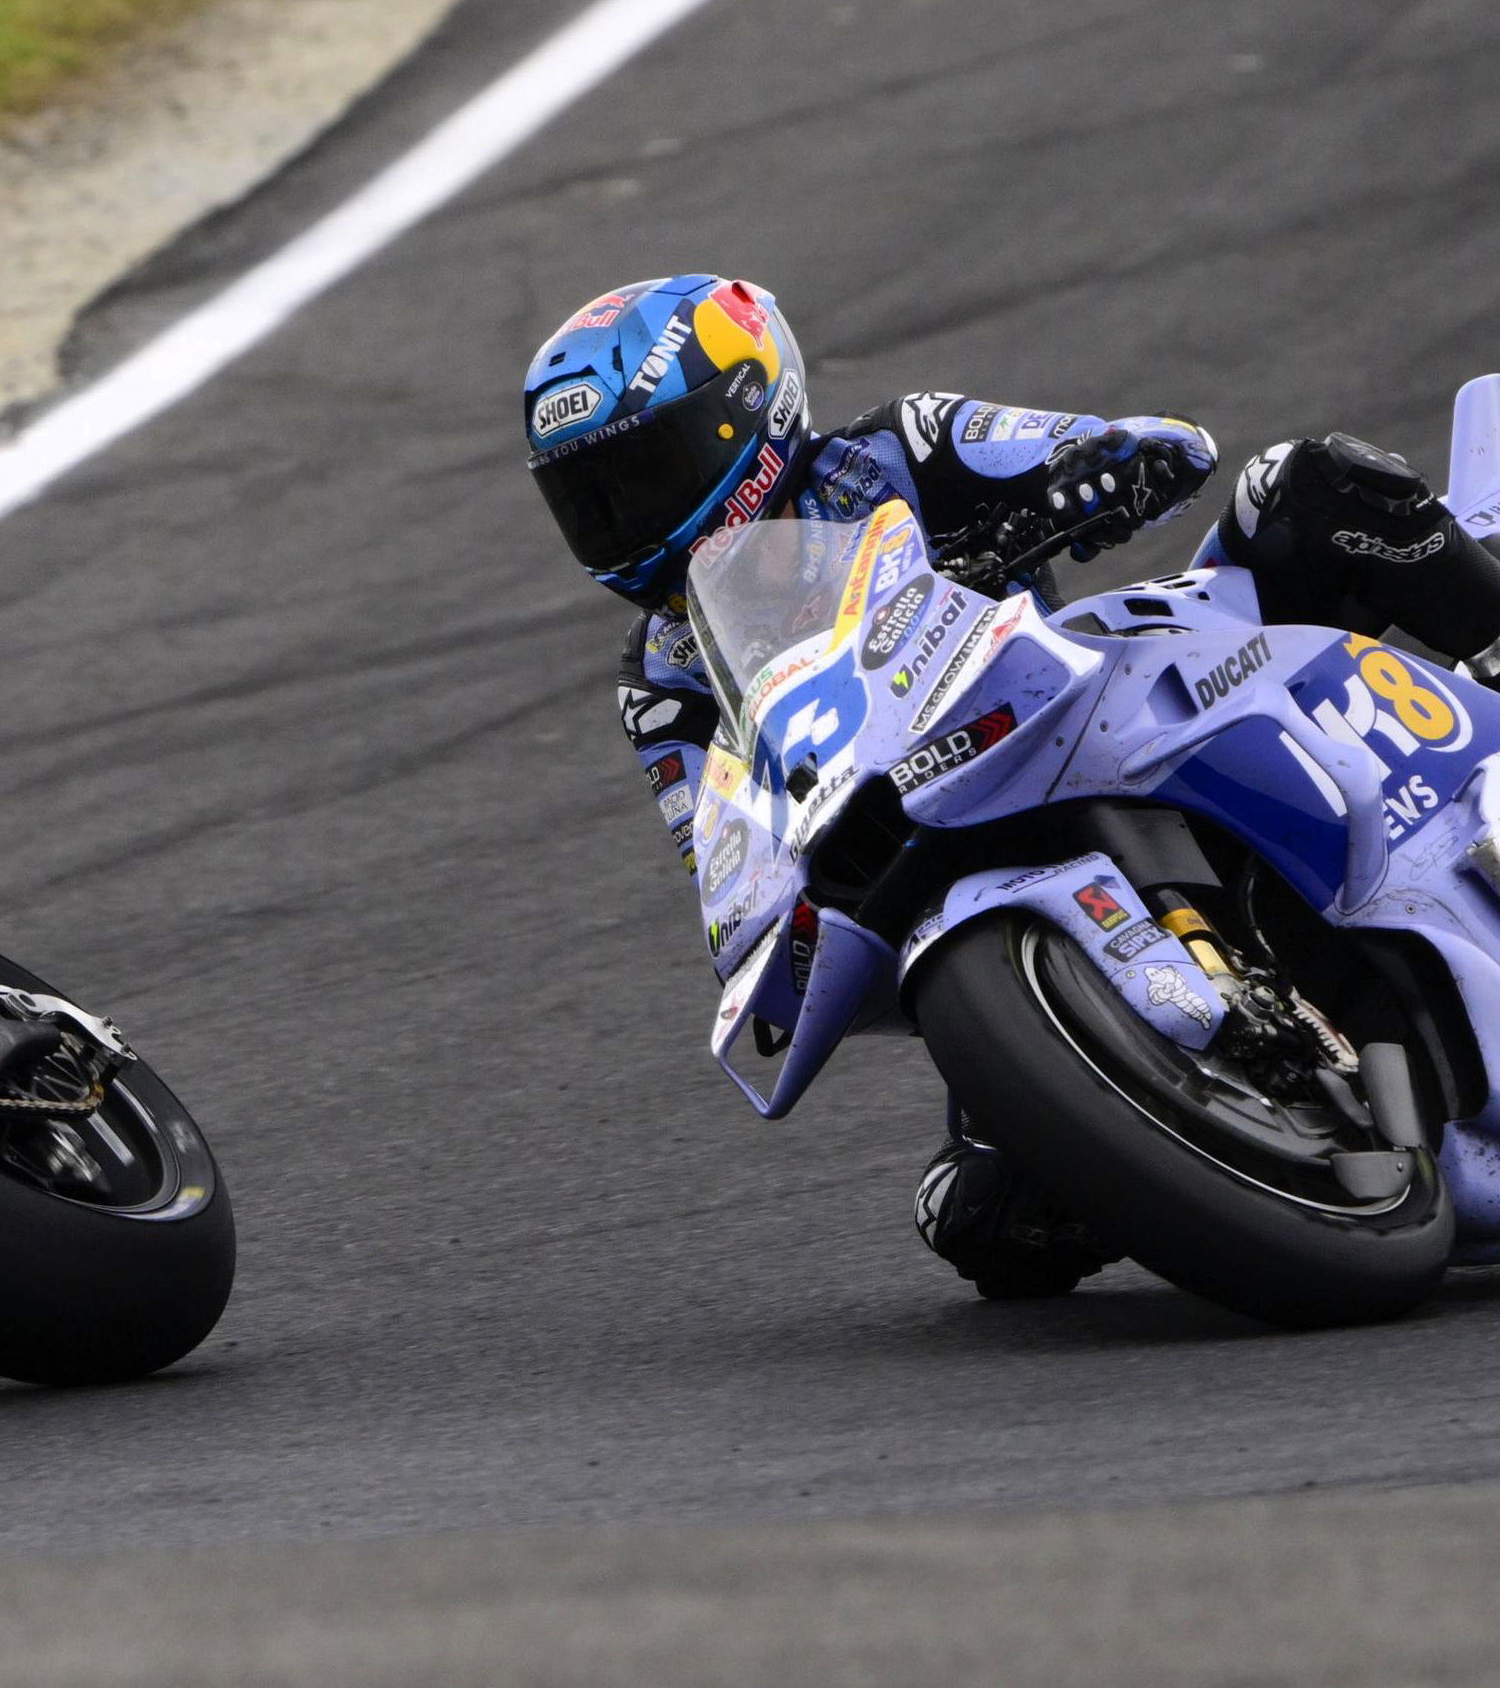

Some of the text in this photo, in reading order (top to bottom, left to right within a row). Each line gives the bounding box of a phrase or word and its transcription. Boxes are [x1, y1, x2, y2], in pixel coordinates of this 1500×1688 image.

[725, 363, 751, 398] VERTICAL
[773, 375, 799, 432] SHOEI
[537, 390, 589, 430] SHOEI
[584, 415, 641, 445] WINGS
[735, 441, 785, 515] Bull
[889, 589, 968, 698] Unibat
[1194, 631, 1273, 711] DUCATI
[889, 730, 972, 787] BOLD
[898, 747, 977, 795] RIDERS
